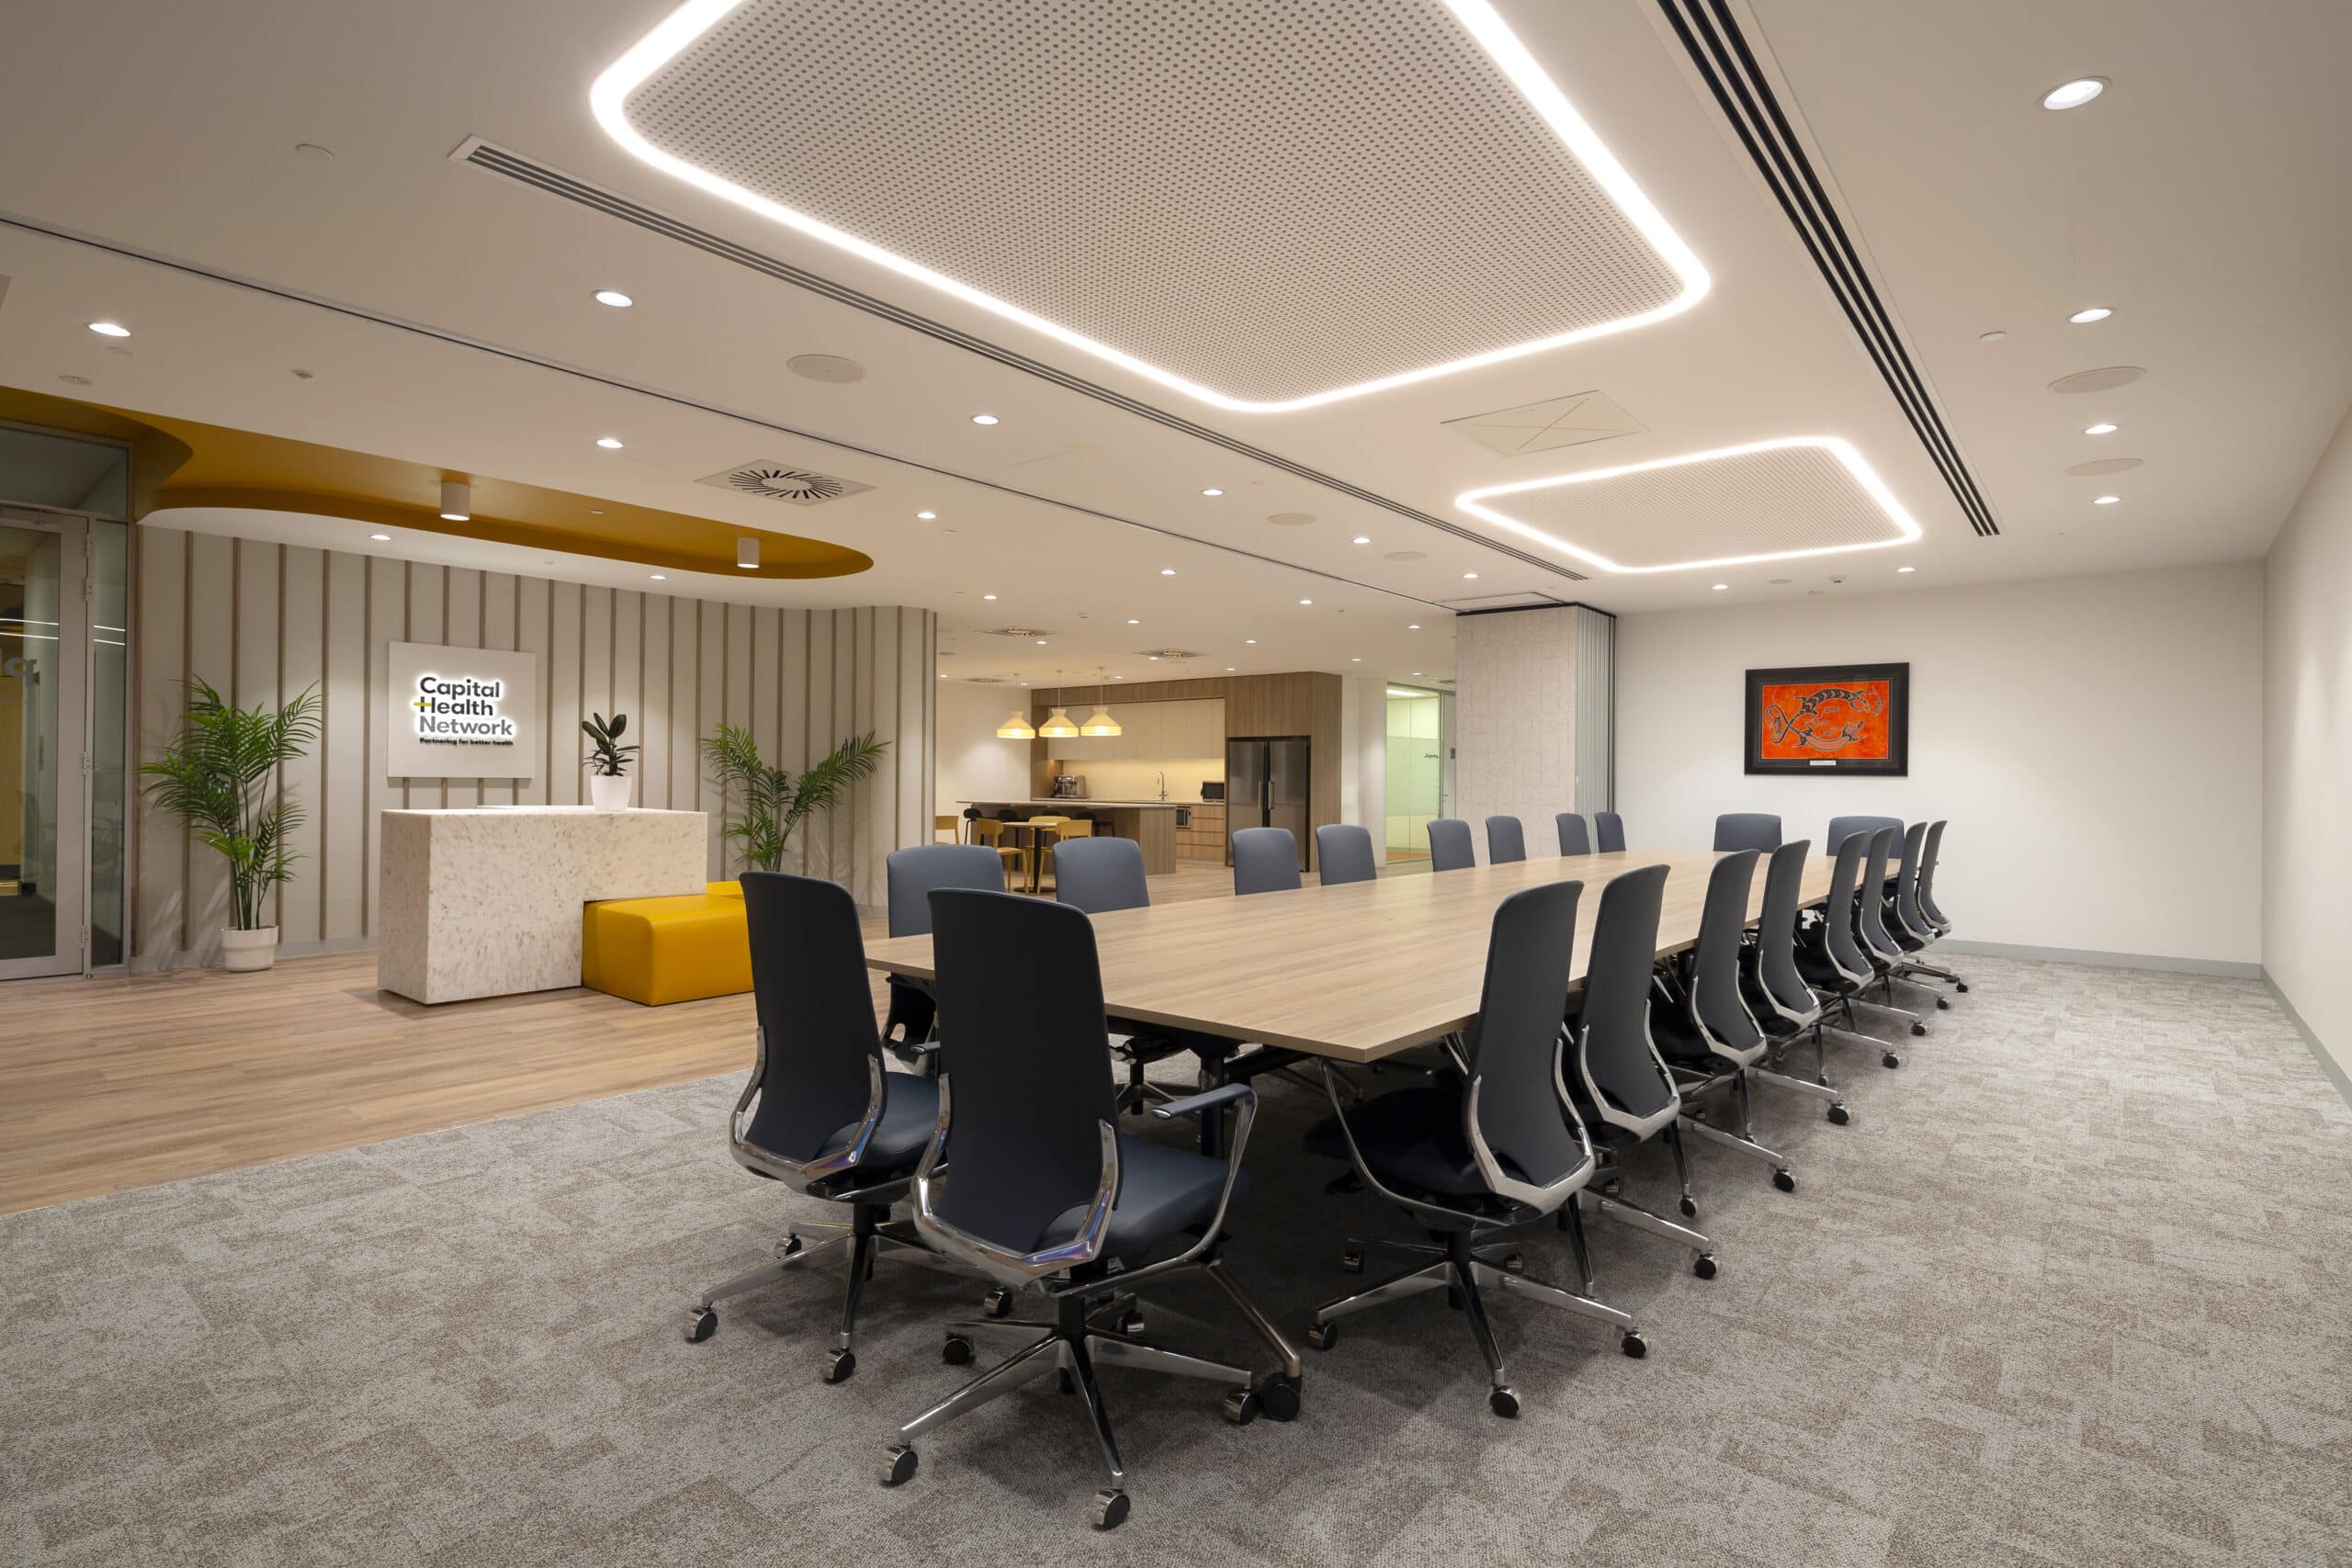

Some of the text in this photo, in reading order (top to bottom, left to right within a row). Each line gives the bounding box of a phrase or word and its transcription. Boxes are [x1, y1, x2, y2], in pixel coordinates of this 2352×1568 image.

[420, 676, 500, 700] Capital
[413, 696, 493, 716] Health
[419, 716, 513, 736] Network
[420, 738, 458, 746] Partnering
